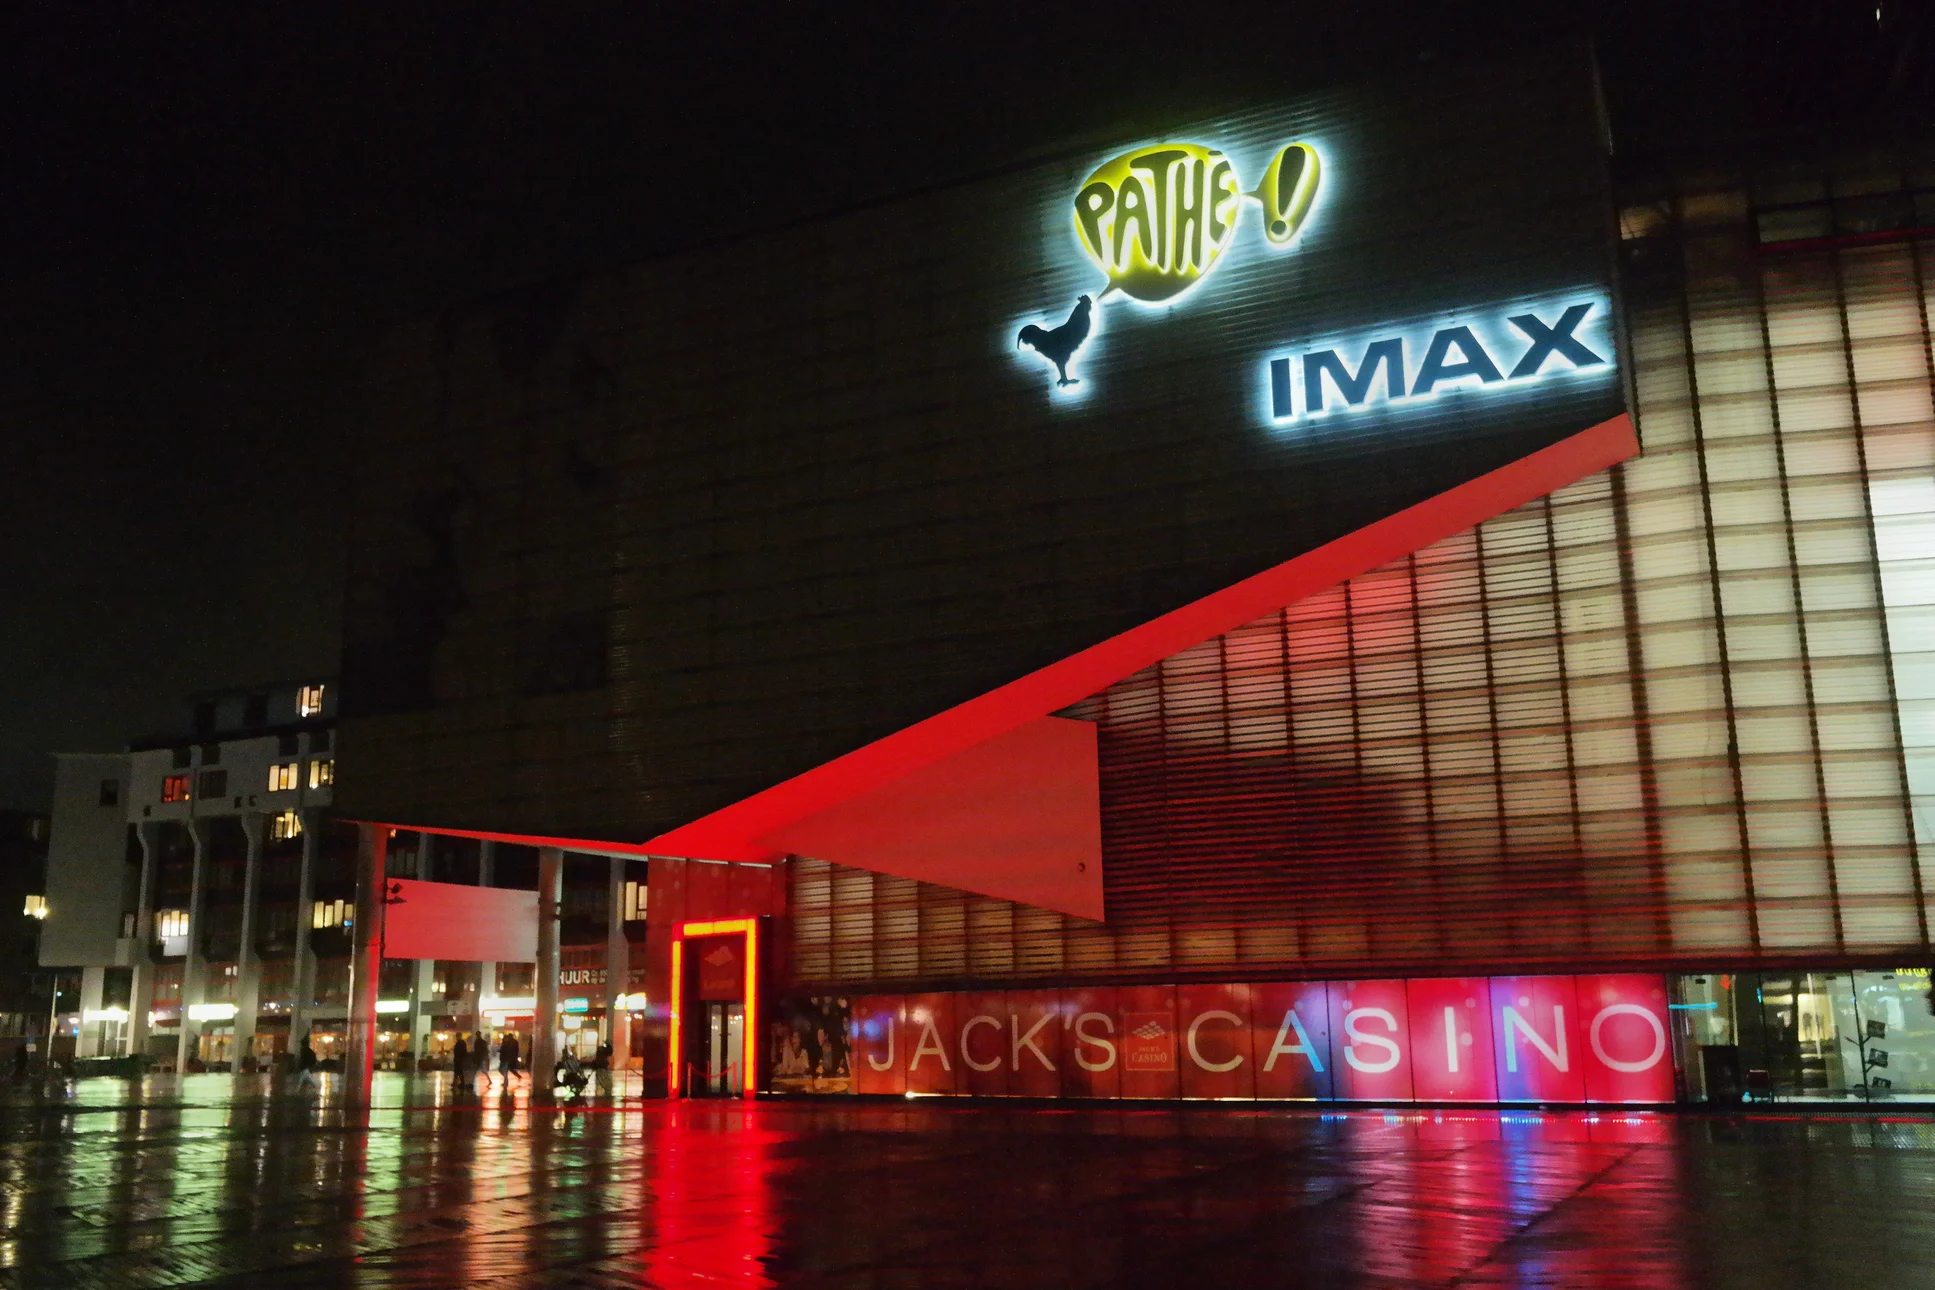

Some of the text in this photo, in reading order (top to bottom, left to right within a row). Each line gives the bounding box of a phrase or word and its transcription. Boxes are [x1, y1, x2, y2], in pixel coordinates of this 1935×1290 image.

[1269, 301, 1606, 419] IMAX
[867, 1003, 1666, 1075] JACK'S CASINO
[1131, 1051, 1168, 1063] CASINO
